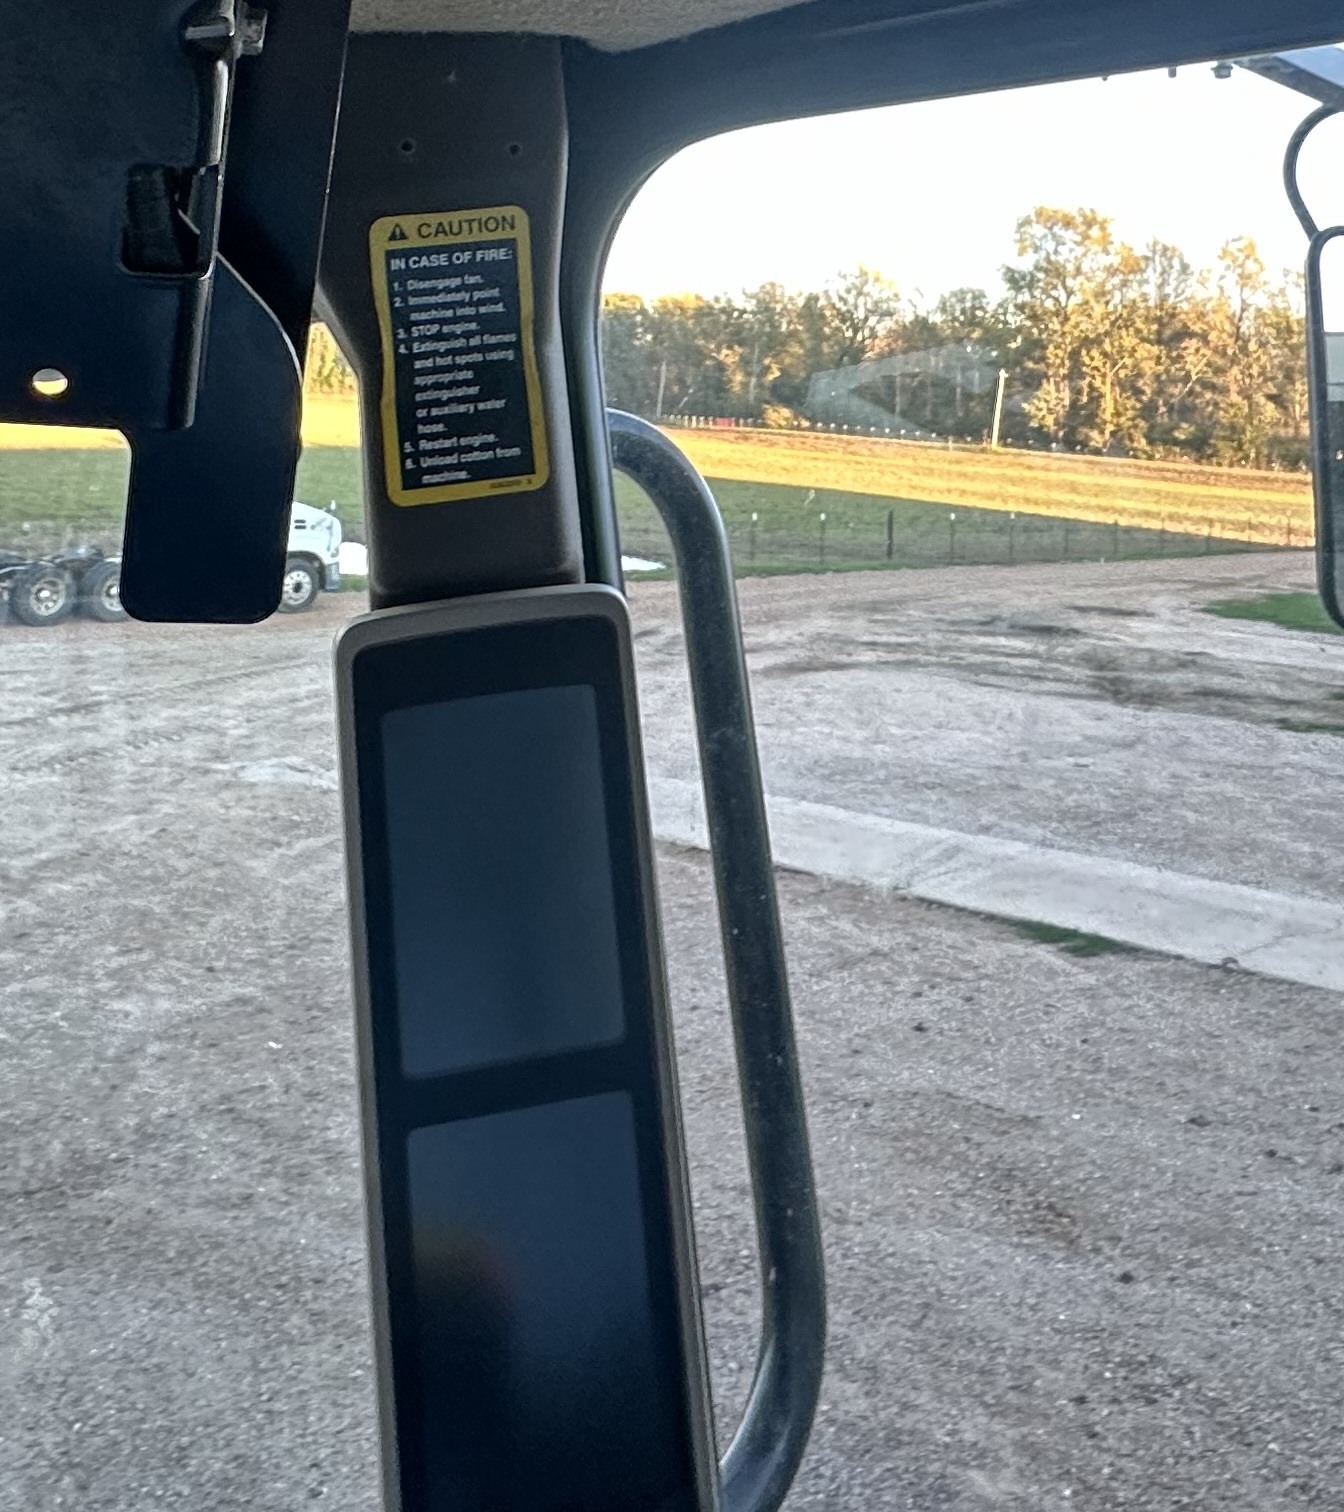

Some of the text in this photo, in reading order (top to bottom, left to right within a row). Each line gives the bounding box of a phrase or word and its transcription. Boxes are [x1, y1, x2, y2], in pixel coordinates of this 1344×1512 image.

[417, 214, 516, 239] CAUTION
[390, 247, 513, 271] IN CASE OF FIRE:
[392, 273, 485, 292] 1. Disengage fan.
[393, 288, 501, 308] 2. Immediately point
[409, 302, 506, 322] machine into wind.
[396, 321, 480, 339] 3. STOP engine.
[398, 333, 517, 354] 4. Extinguish all flames
[413, 349, 515, 369] and hot spots using
[413, 369, 475, 386] appropriate
[414, 385, 481, 402] extinguisher
[415, 398, 507, 418] or auxiliary water
[416, 423, 448, 435] hose.
[418, 437, 458, 451] Restart
[459, 433, 500, 447] engine.
[419, 453, 459, 468] Unload
[459, 449, 495, 463] cotton
[495, 446, 522, 459] from
[421, 469, 472, 485] machine.
